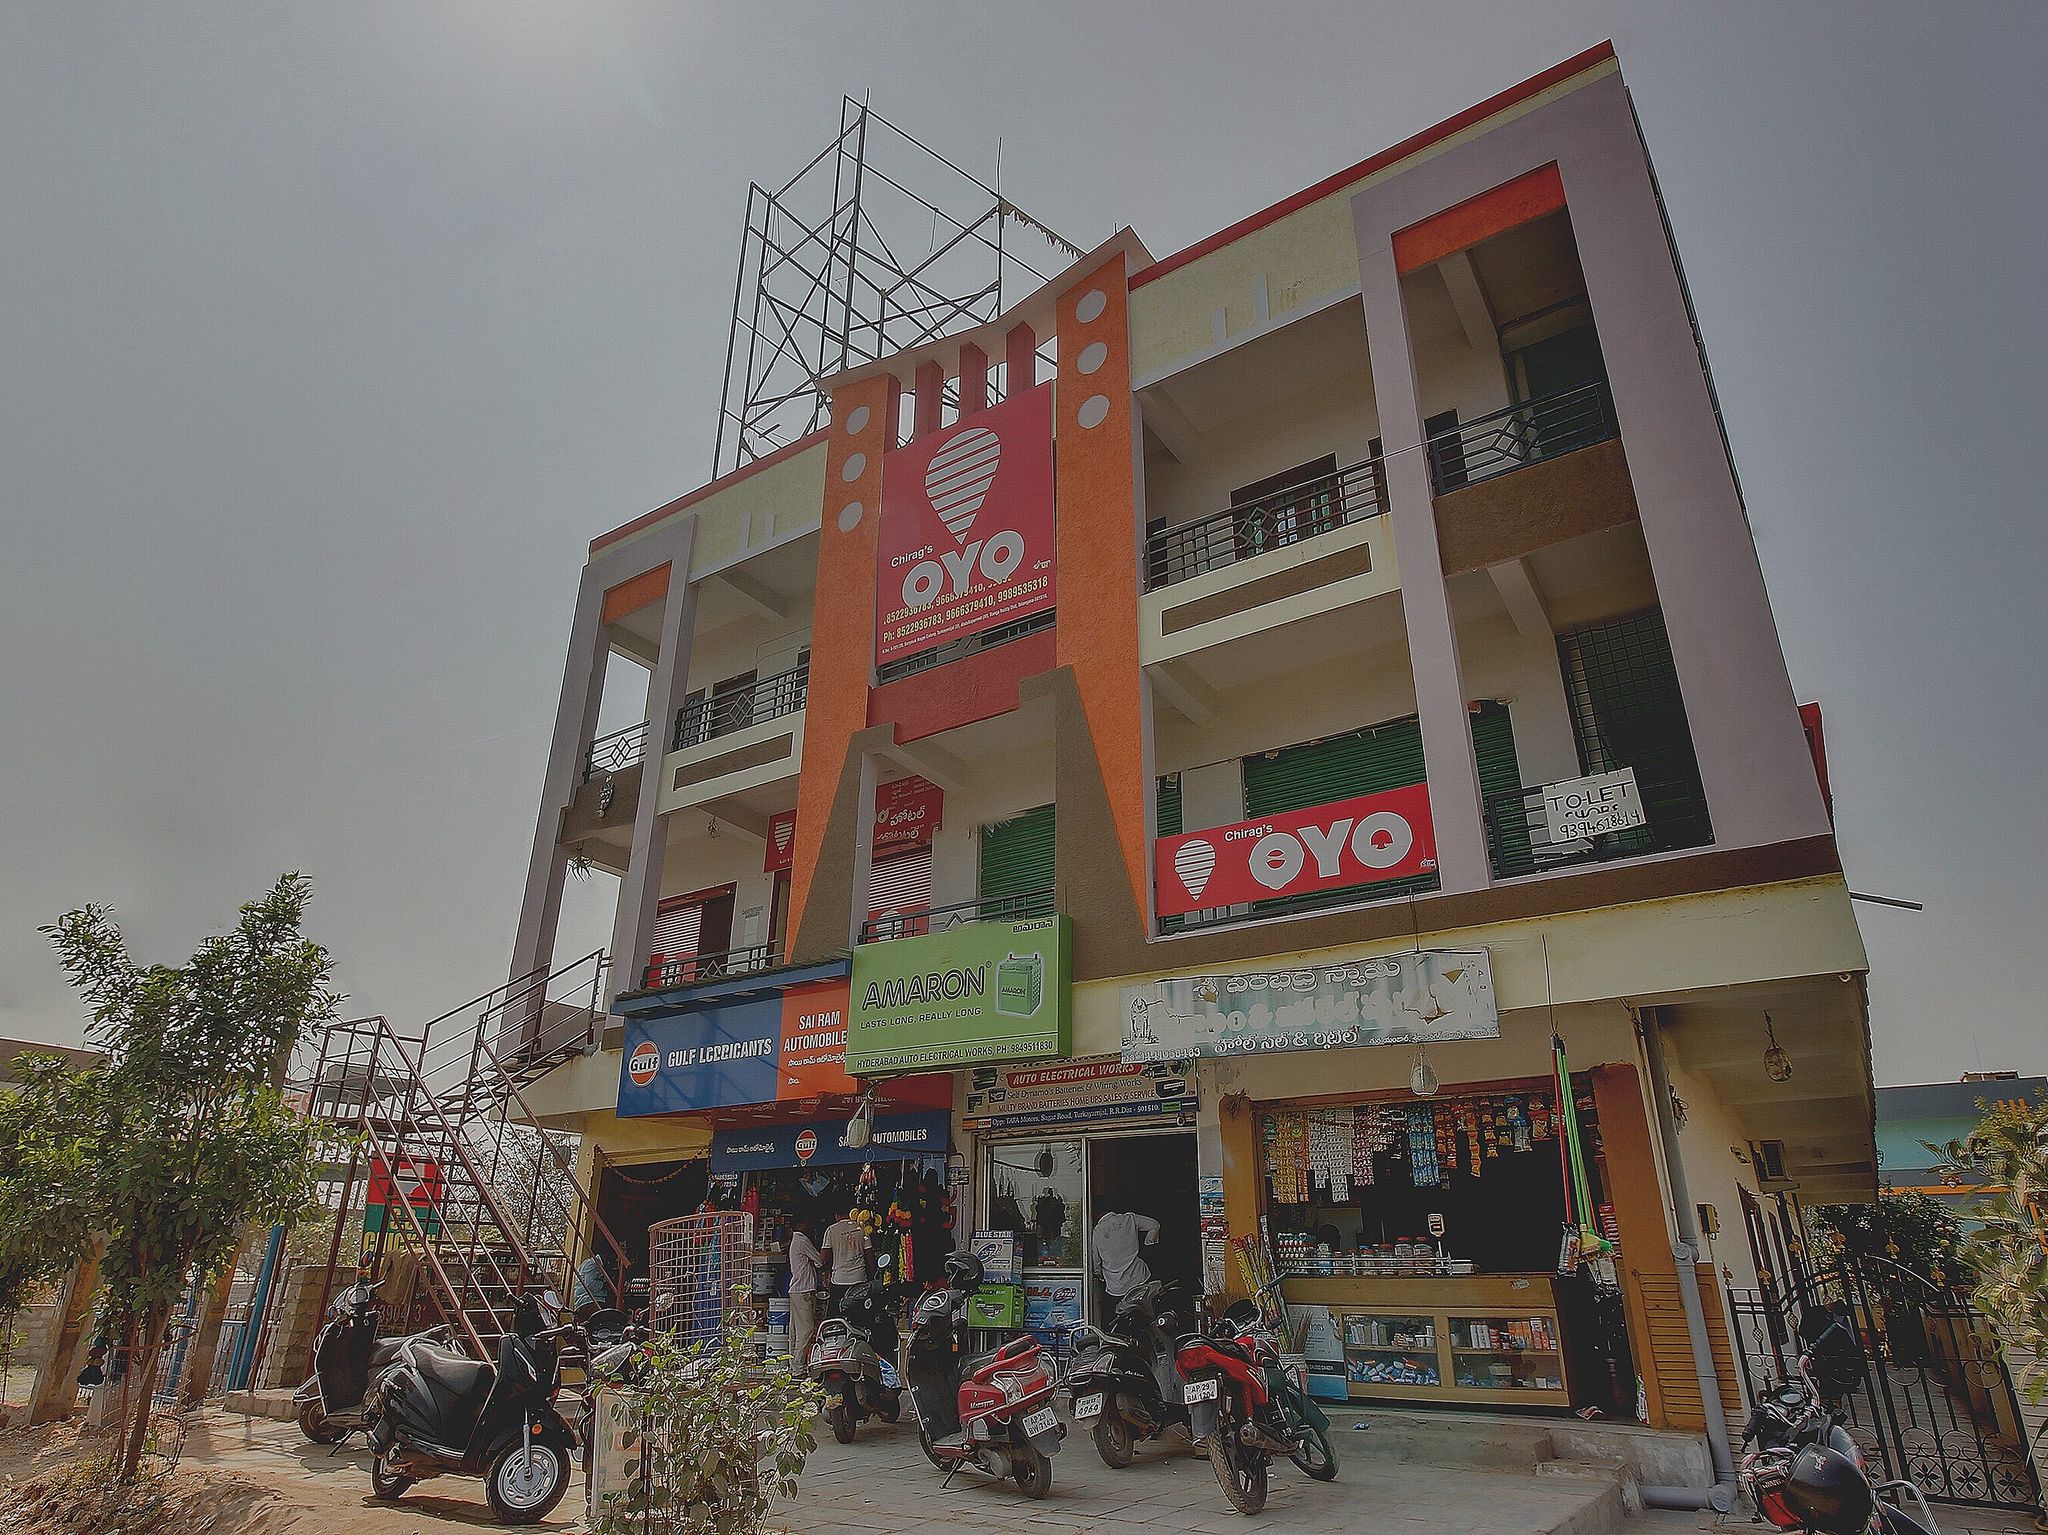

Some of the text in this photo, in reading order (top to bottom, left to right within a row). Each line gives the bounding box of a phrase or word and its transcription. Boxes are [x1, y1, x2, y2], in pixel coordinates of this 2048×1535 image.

[891, 544, 934, 568] Chirag's
[902, 530, 1025, 608] OYO
[883, 630, 895, 643] Ph:
[896, 613, 944, 638] 8522936783,
[945, 594, 996, 620] 9666379410,
[997, 575, 1048, 602] 9989535318
[1546, 780, 1634, 812] TO-LET
[1224, 822, 1273, 843] Chirag's
[1249, 811, 1413, 891] OYO
[862, 964, 986, 1012] AMARON
[799, 1010, 841, 1030] SAI RAM
[861, 1007, 984, 1030] LASTS LONG. REALLY LONG.
[783, 1031, 848, 1053] AUTOMOBILE
[1292, 1031, 1309, 1047] &
[629, 1054, 660, 1073] Gulf
[667, 1049, 696, 1068] GULF
[857, 1040, 1053, 1069] HYDERABAD AUTO ELECTRICAL WORKS, PH: 9849511830
[1013, 1063, 1136, 1086] AUTO ELECTRICAL WORKS
[1017, 1101, 1038, 1111] BRAND
[1071, 1096, 1090, 1106] HOME
[1091, 1094, 1102, 1104] UPS
[1104, 1092, 1121, 1102] SALES
[1130, 1089, 1155, 1099] SERVICE
[795, 1139, 817, 1152] Gulf
[838, 1128, 928, 1148] SA AUTOMOBILES
[1192, 1383, 1210, 1393] AP 29
